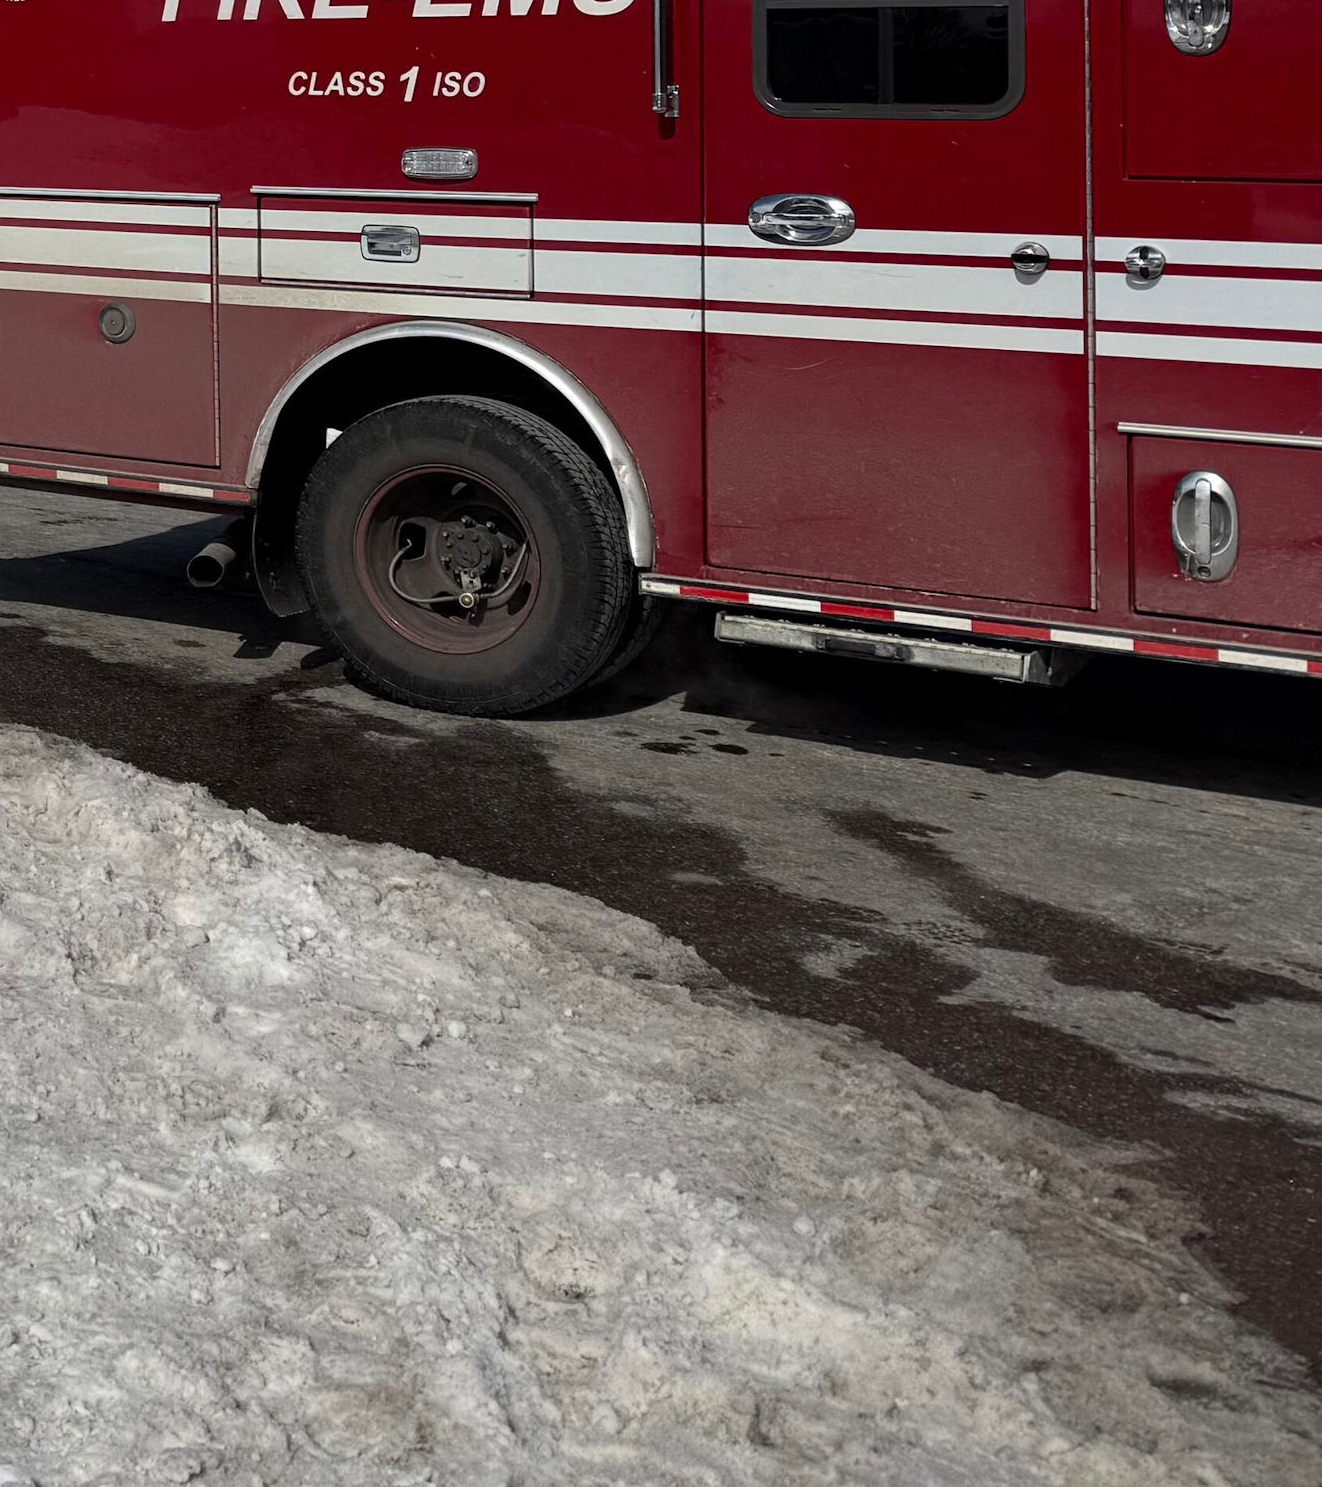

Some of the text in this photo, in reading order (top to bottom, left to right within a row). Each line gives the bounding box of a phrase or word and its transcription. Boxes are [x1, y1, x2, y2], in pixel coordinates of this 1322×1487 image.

[288, 65, 486, 102] CLASS 1 ISO
